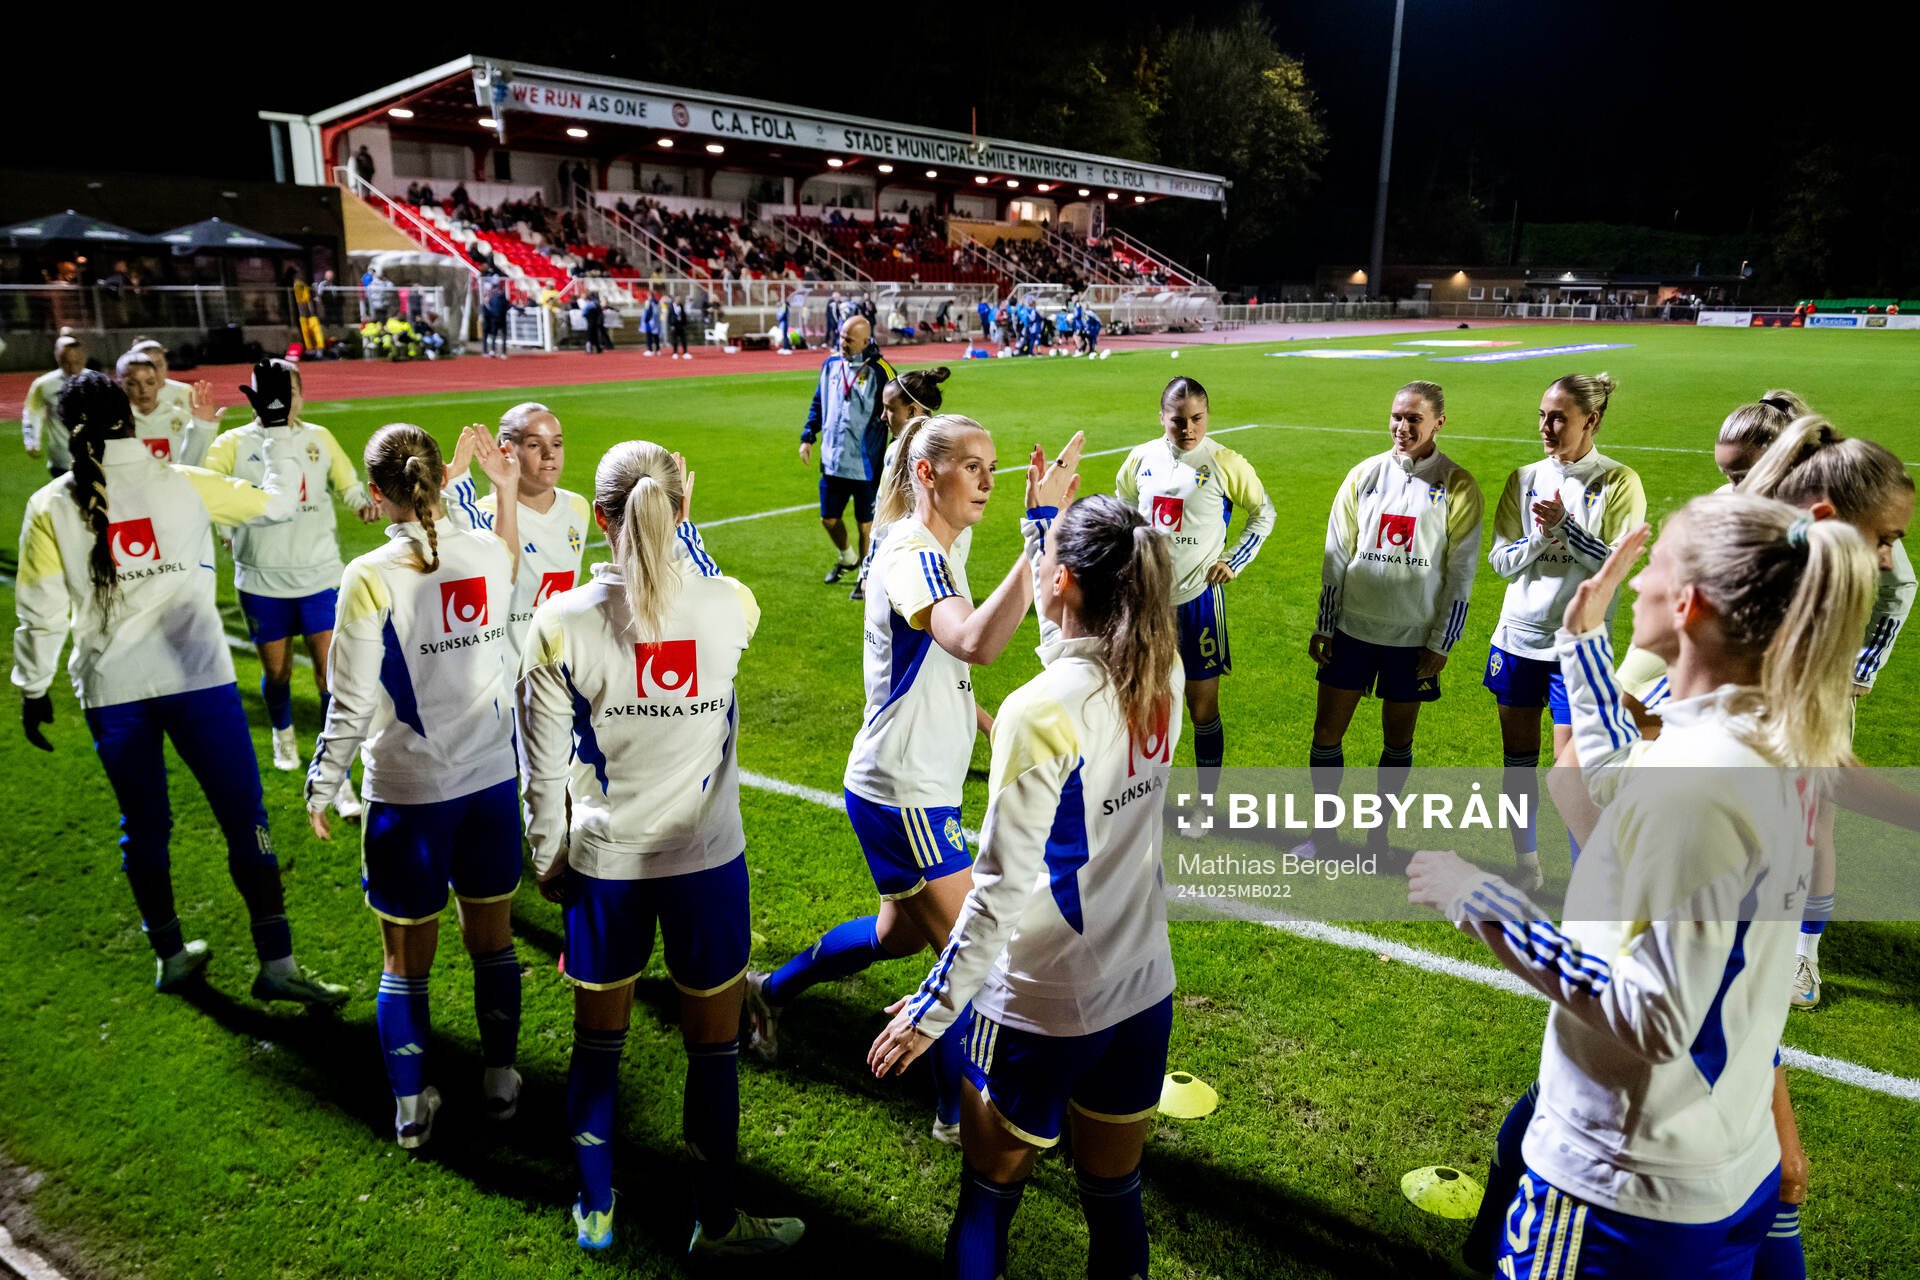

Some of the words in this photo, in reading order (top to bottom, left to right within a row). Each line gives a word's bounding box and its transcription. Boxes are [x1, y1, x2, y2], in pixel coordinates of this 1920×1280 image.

[512, 84, 538, 104] WE
[544, 87, 582, 110] RUN
[587, 95, 609, 113] AS
[614, 98, 647, 118] ONE
[711, 109, 748, 135] C.A.
[751, 115, 797, 141] FOLA
[844, 129, 894, 154] STADE
[896, 136, 975, 166] MUNICIPAL
[1018, 156, 1077, 179] MAYRISCH
[1103, 169, 1121, 185] C.S.
[1123, 171, 1145, 189] FOLA
[1175, 536, 1199, 545] SPEL
[157, 561, 186, 576] SPEL
[1359, 551, 1401, 564] SVENSKA
[1405, 555, 1430, 567] SPEL
[420, 634, 480, 655] SVENSKA
[484, 626, 505, 643] SPEL
[1199, 626, 1216, 657] 6
[604, 704, 684, 719] SVENSKA
[690, 697, 726, 716] SPEL
